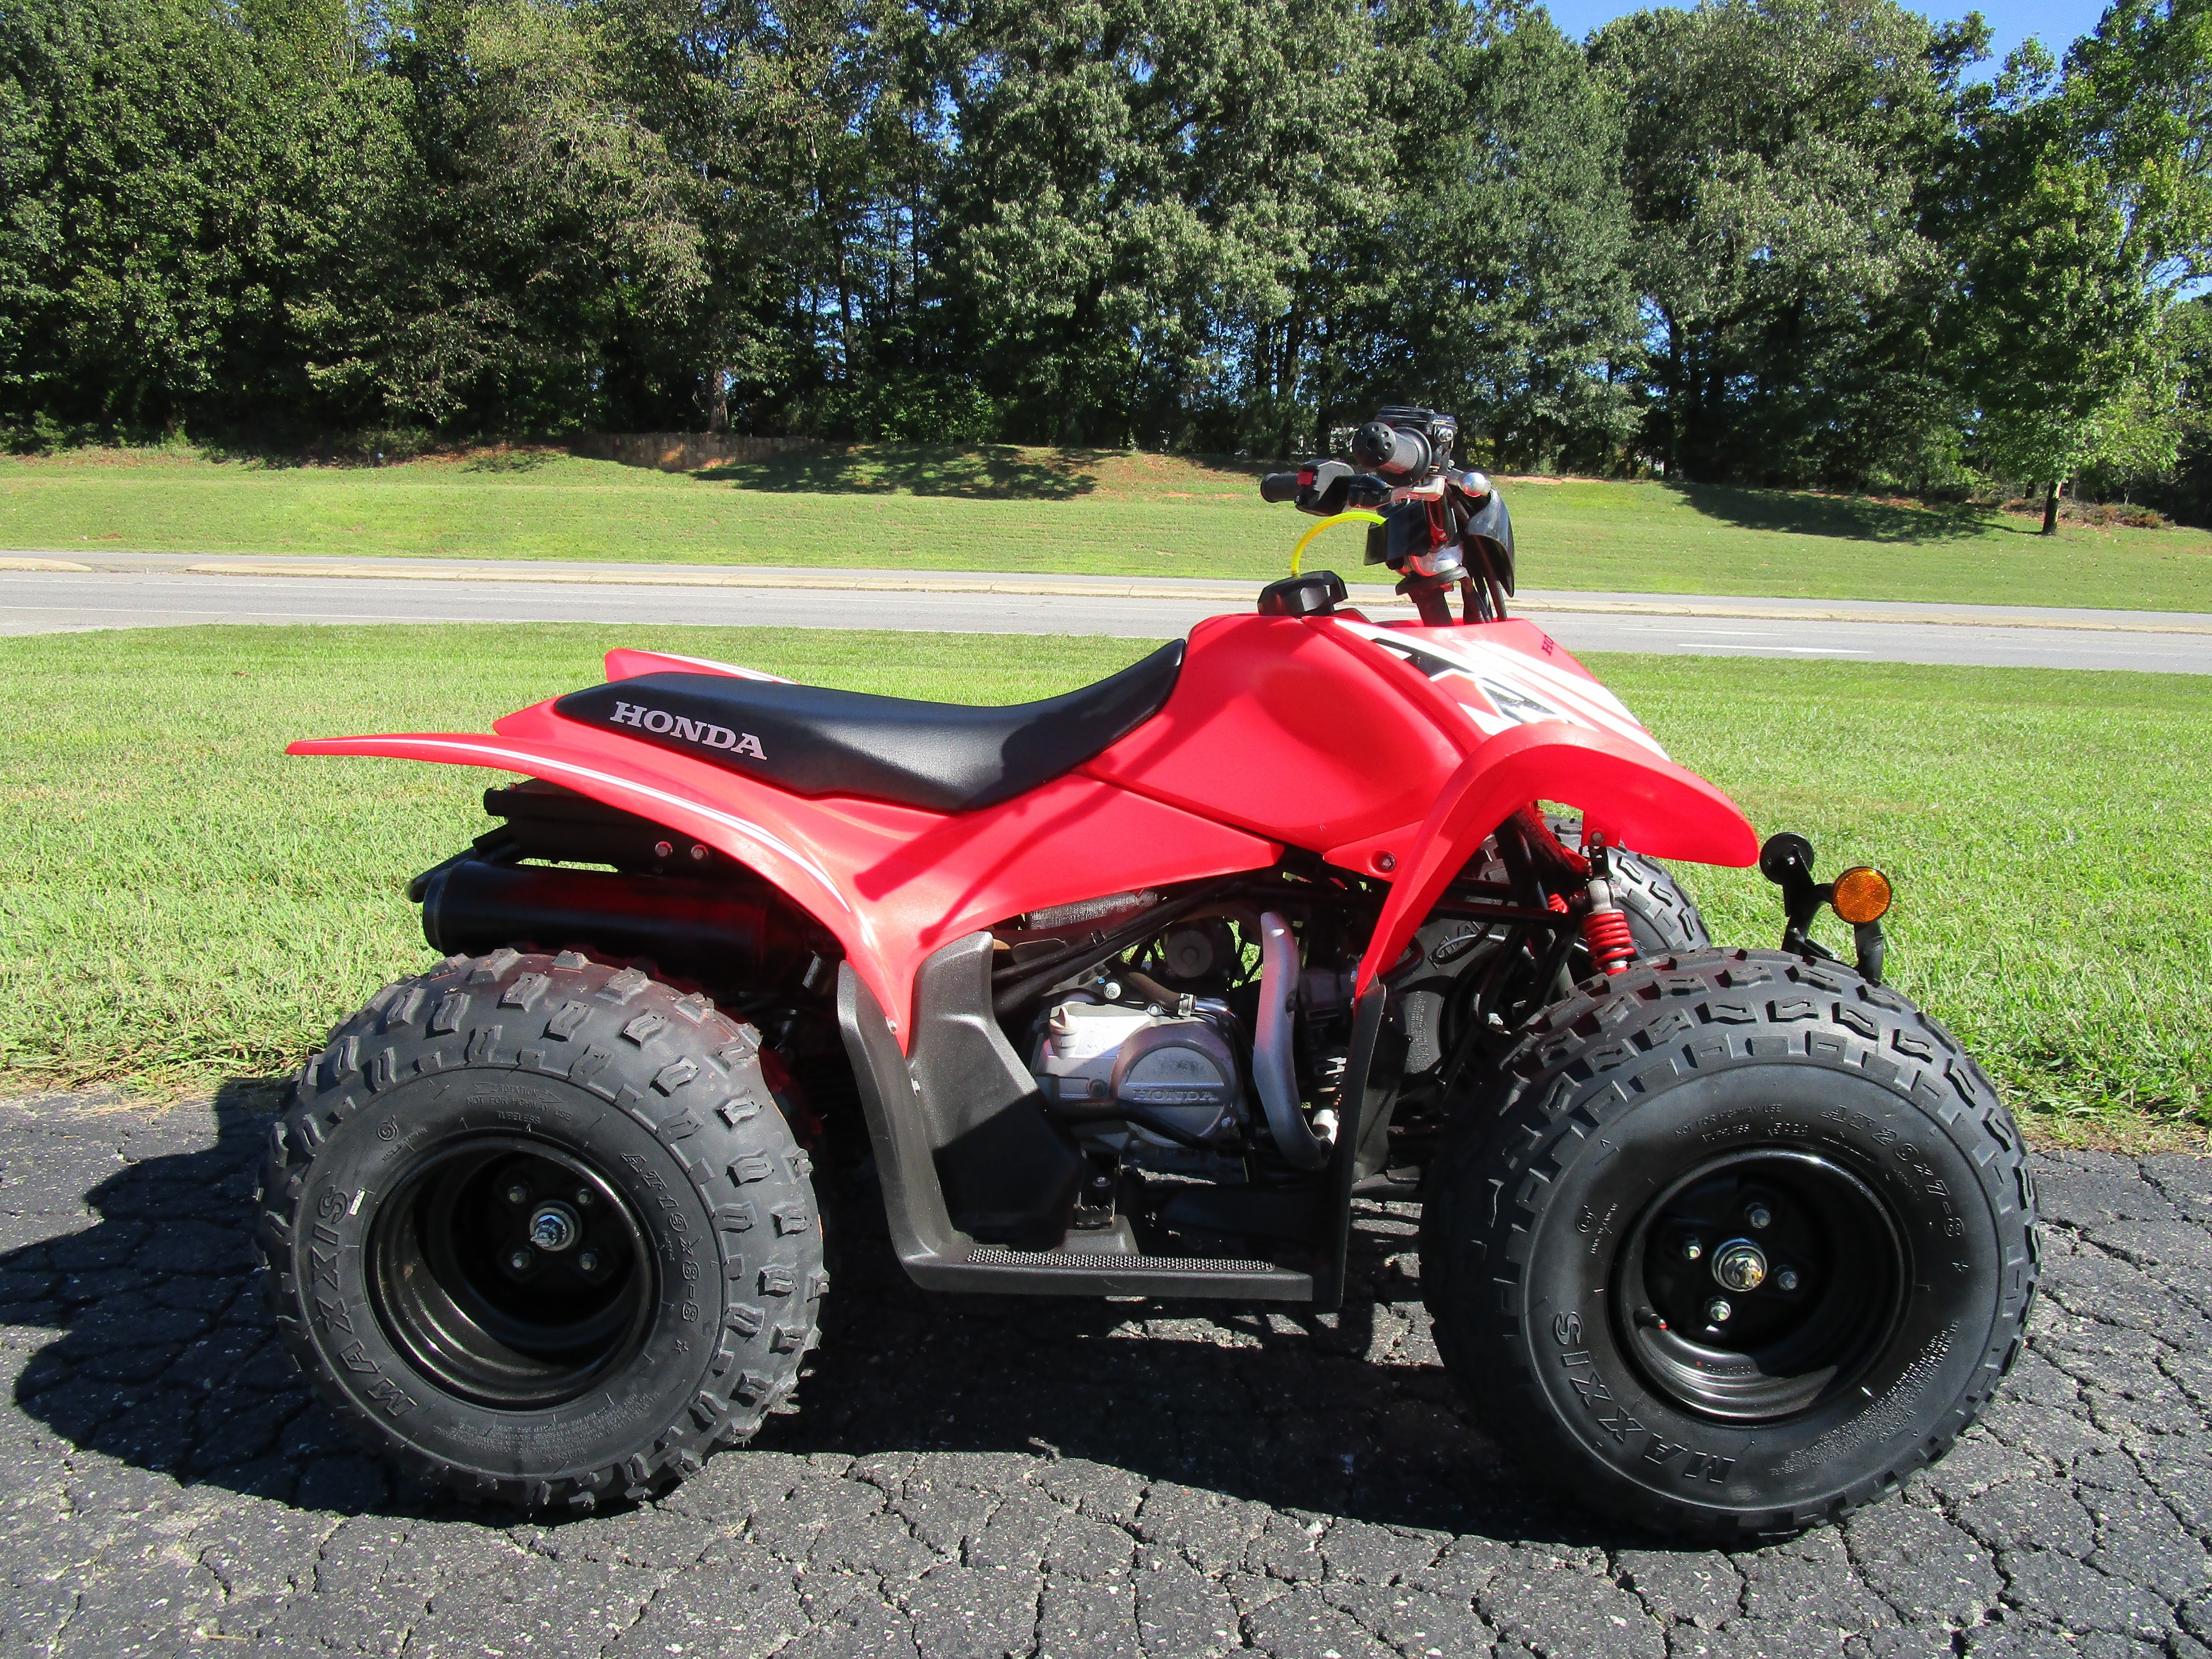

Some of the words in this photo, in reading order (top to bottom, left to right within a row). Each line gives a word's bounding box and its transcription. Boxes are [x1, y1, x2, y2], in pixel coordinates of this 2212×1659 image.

[609, 700, 768, 760] HONDA
[499, 1084, 538, 1097] ROTATION
[1133, 1089, 1220, 1102] HONDA
[466, 1097, 484, 1106] NOT
[489, 1096, 507, 1105] FOR
[511, 1098, 549, 1112] HIGHWAY
[554, 1108, 573, 1121] USE
[496, 1111, 541, 1124] TUBELESS
[1675, 1124, 1692, 1137] NOT
[1696, 1114, 1717, 1127] FOR
[1763, 1104, 1782, 1113] USE
[620, 1152, 701, 1323] AT19x8-8
[310, 1185, 418, 1416] MAXXIS
[1552, 1310, 1736, 1483] MAXXIS
[1876, 1410, 1917, 1443] WARNING
